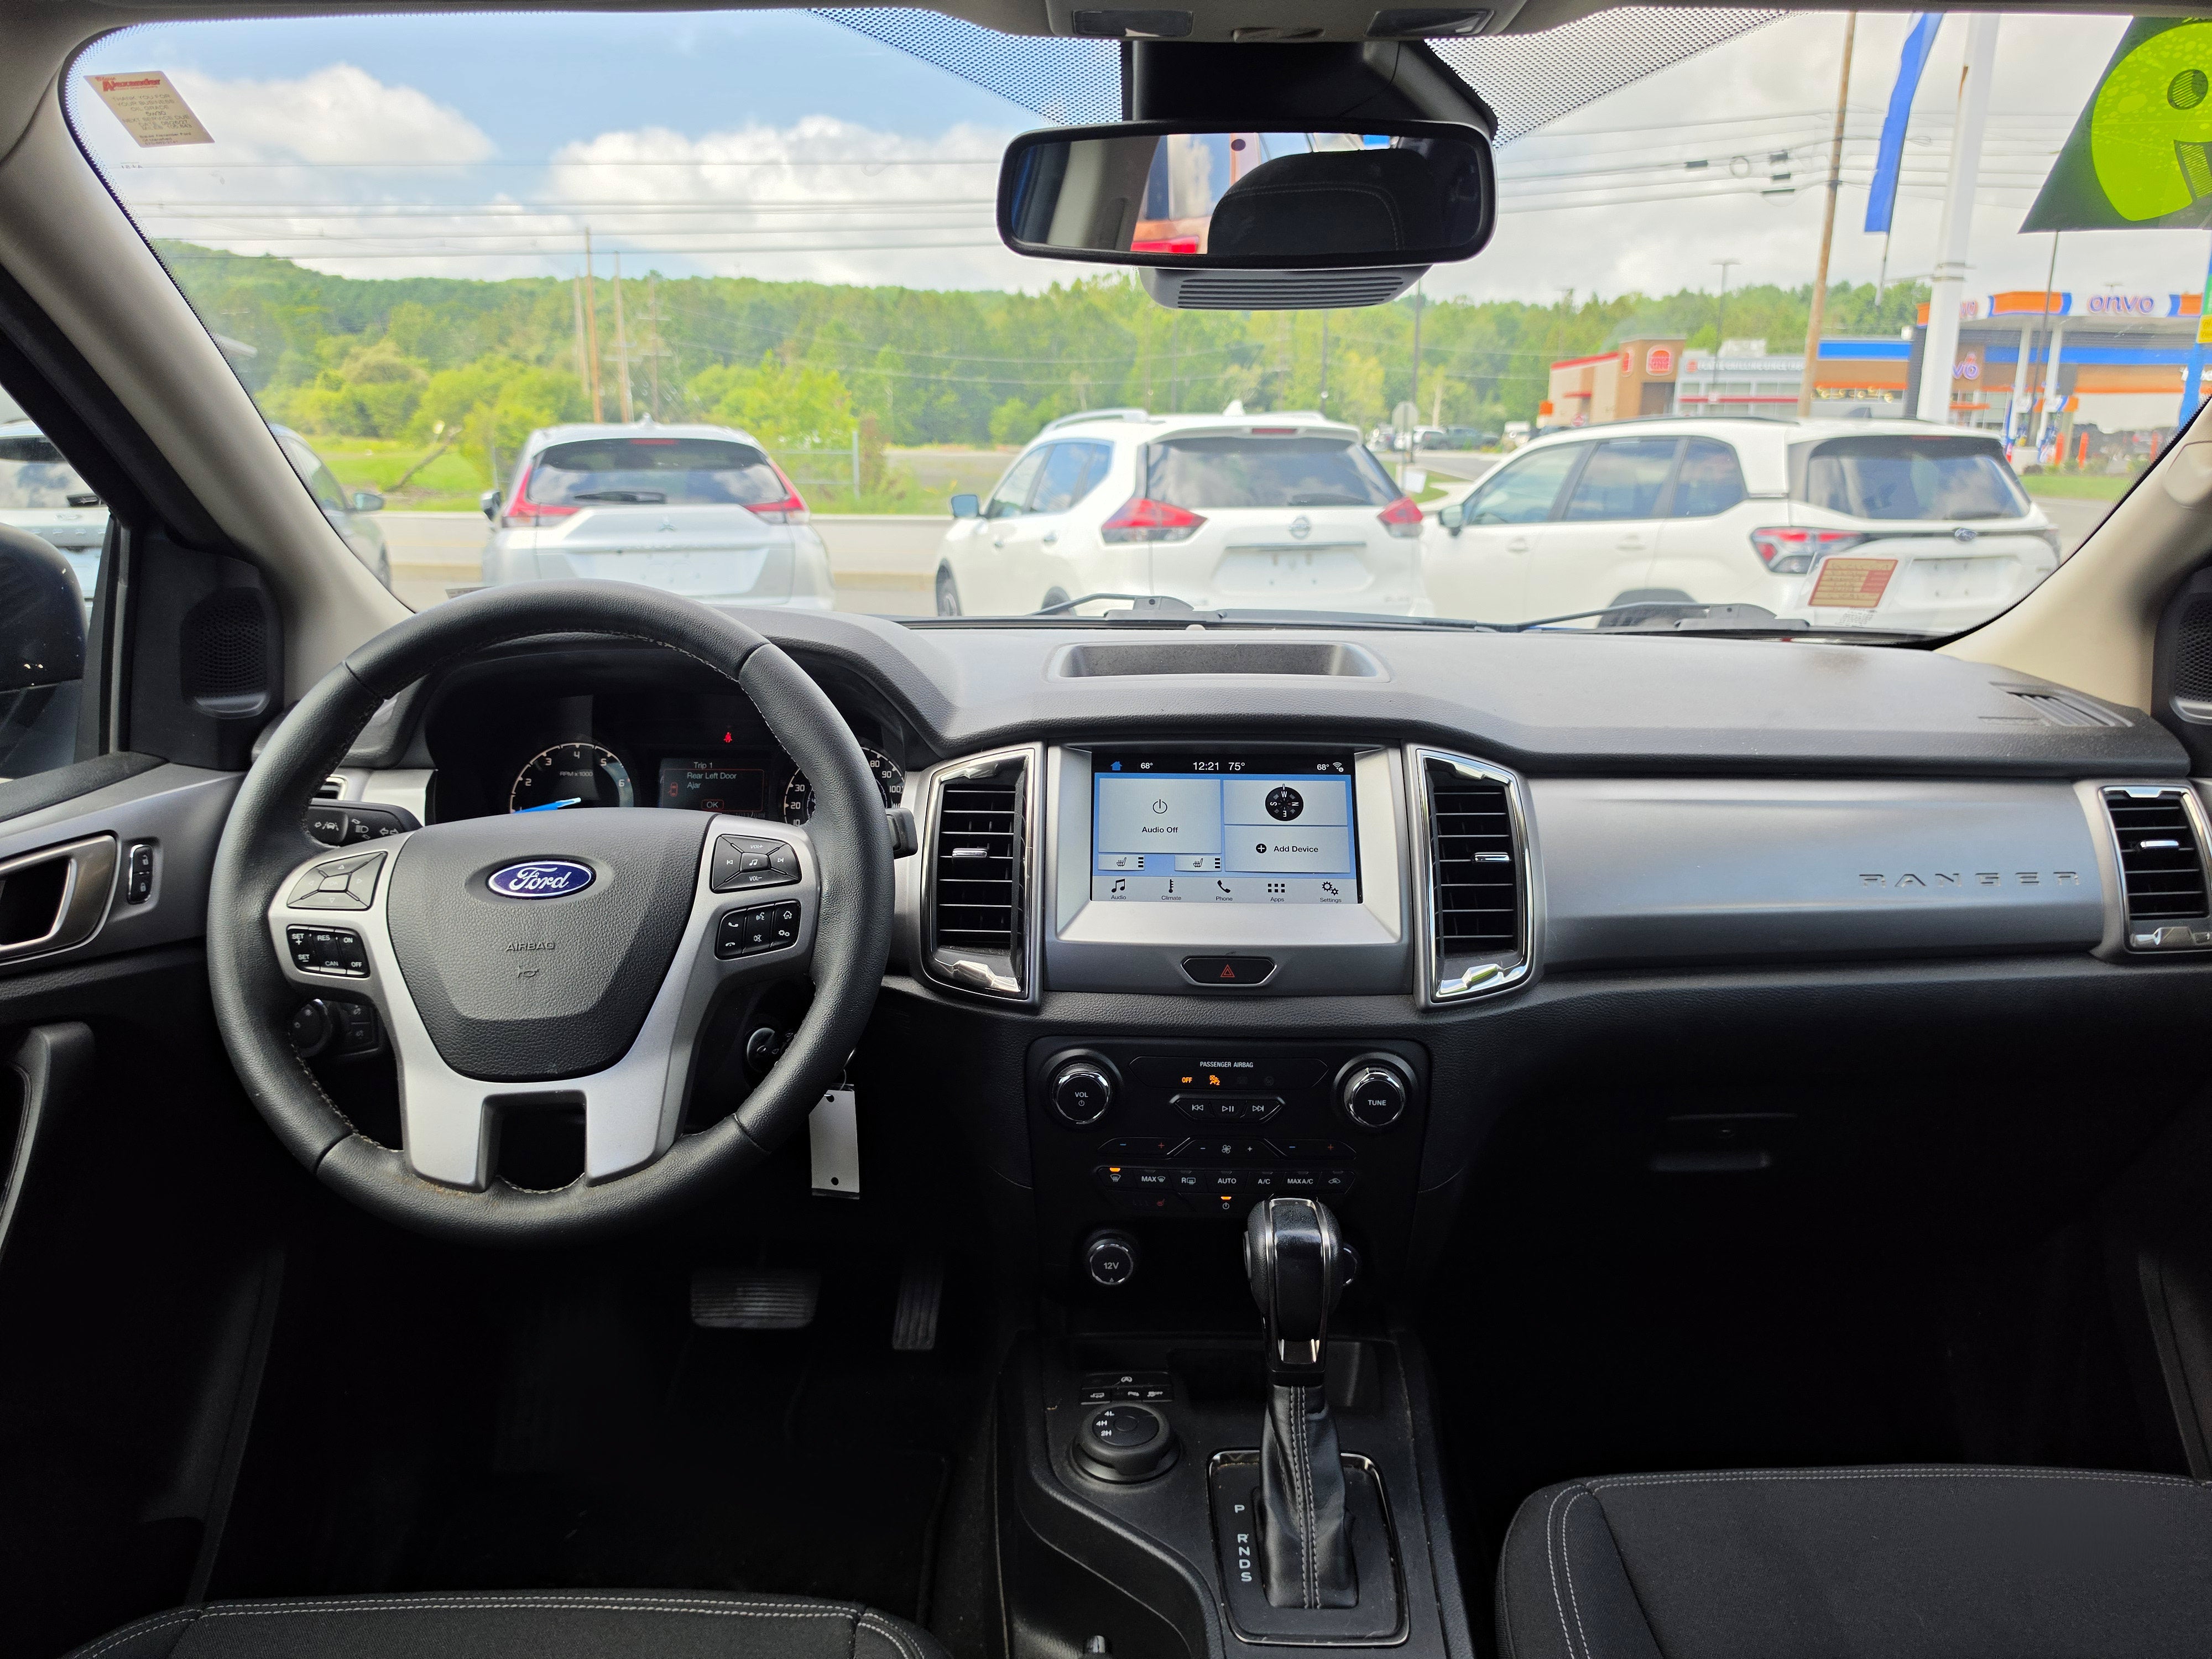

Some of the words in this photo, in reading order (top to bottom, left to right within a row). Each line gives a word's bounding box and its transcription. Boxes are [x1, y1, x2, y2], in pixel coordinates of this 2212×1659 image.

[2088, 294, 2155, 315] onvo
[545, 758, 552, 766] 3
[601, 758, 607, 766] 5
[693, 761, 707, 770] Trip
[870, 760, 880, 768] 80
[1193, 761, 1219, 770] 12:21
[1228, 762, 1245, 771] 75°
[881, 770, 892, 779] 90
[525, 778, 531, 786] 2
[619, 779, 625, 787] 6
[790, 801, 801, 810] 20
[509, 867, 572, 890] Ford
[1859, 872, 2080, 888] RANGER
[505, 941, 556, 952] AIRBAG
[1234, 1504, 1245, 1514] P
[1237, 1533, 1248, 1543] R
[1238, 1546, 1251, 1556] N
[1239, 1559, 1251, 1569] D
[1240, 1572, 1253, 1582] S
